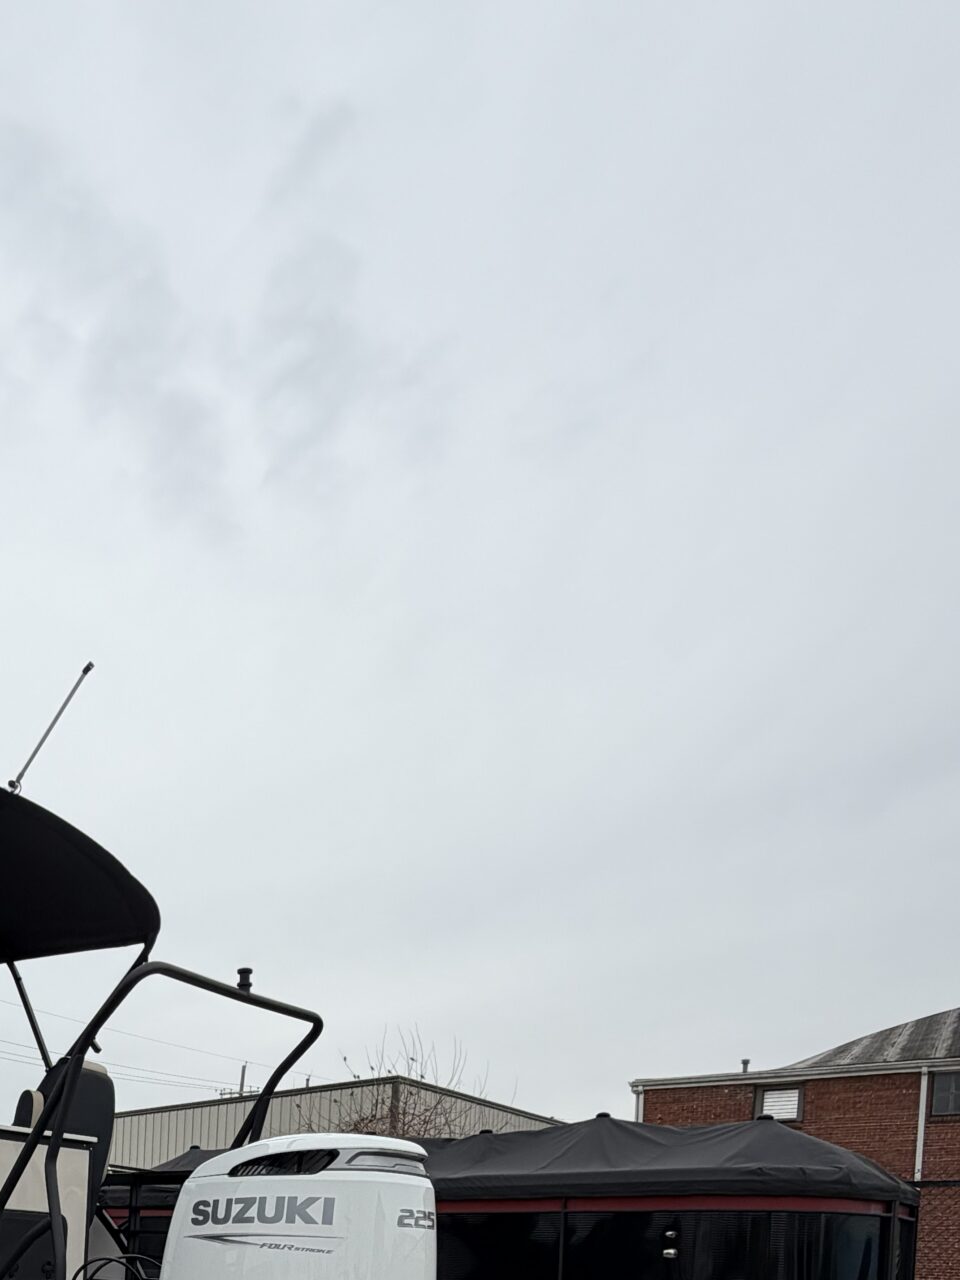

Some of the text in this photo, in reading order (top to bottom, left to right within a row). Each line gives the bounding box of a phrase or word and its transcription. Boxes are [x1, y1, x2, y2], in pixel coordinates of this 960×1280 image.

[191, 1196, 336, 1226] SUZUKI
[397, 1208, 435, 1230] 225
[259, 1242, 335, 1255] FOUR STROKE
